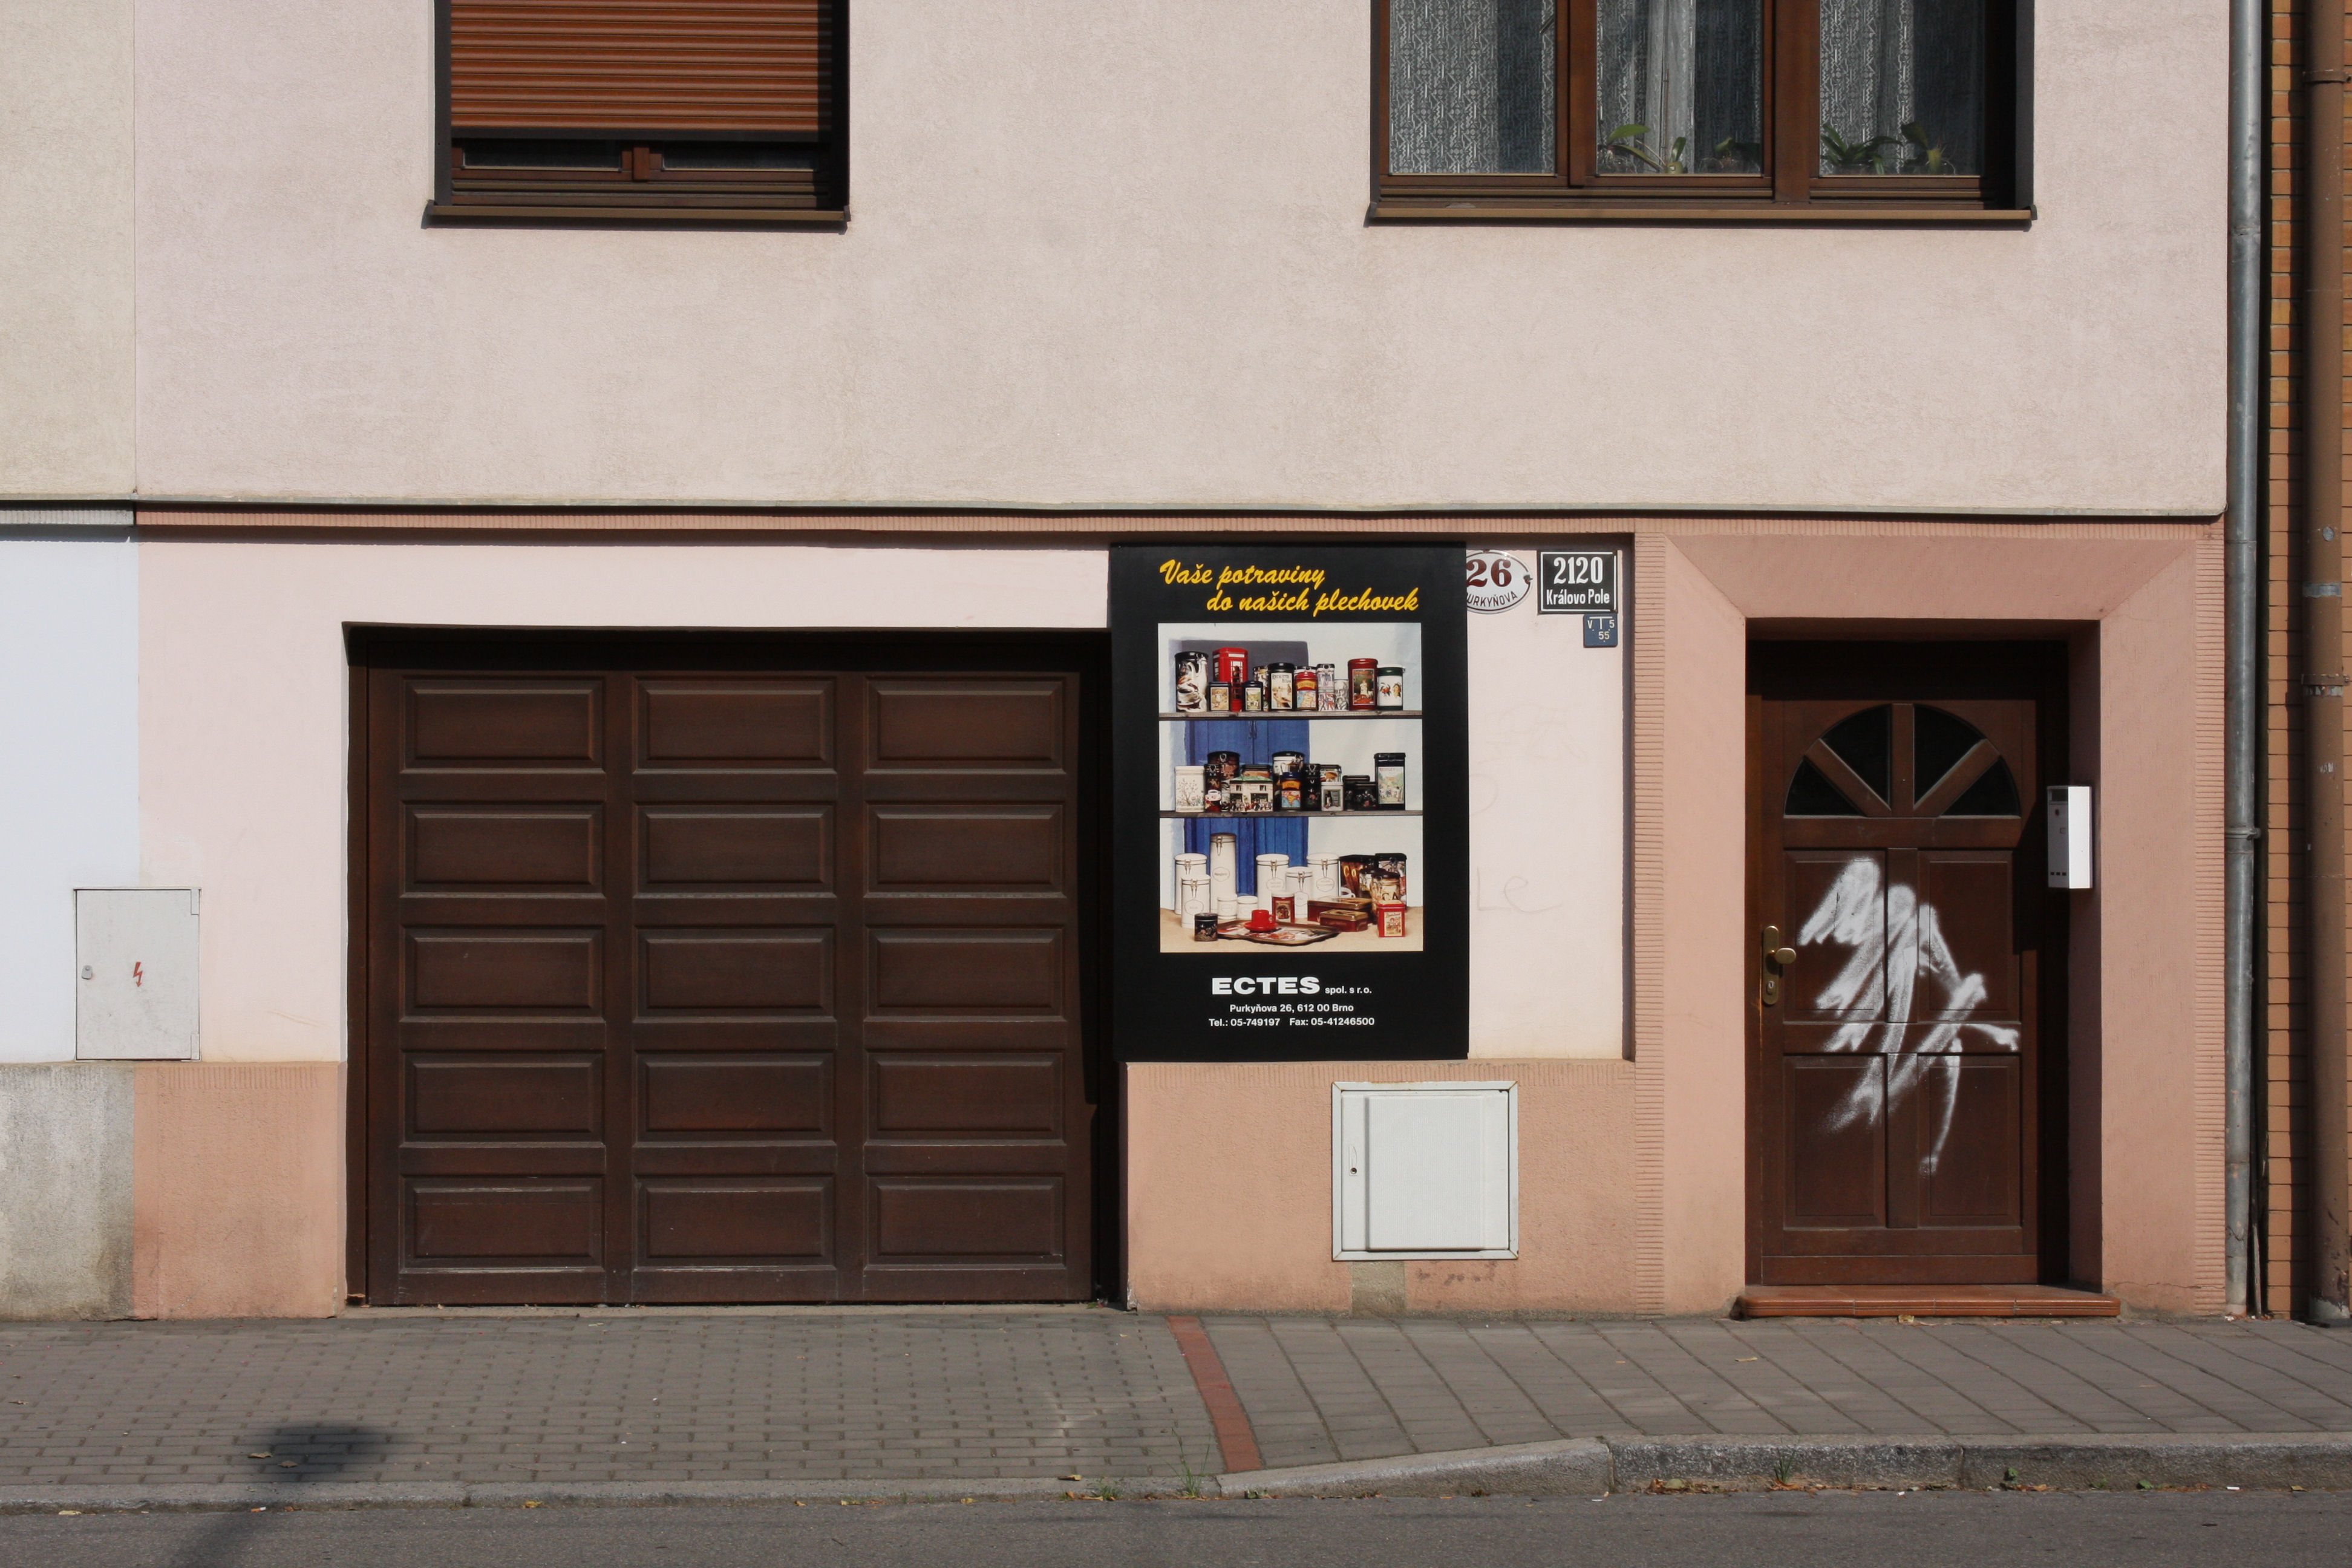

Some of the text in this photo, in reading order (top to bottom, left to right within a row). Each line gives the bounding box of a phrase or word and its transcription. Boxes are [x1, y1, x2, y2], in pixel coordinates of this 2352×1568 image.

[1160, 559, 1325, 590] Vaše potraviny
[1466, 558, 1512, 587] 26
[1553, 557, 1603, 584] 2120
[1206, 587, 1419, 617] do našich plechovek
[1466, 590, 1518, 607] URKYŇOVA
[1546, 589, 1610, 605] Královo Pole
[1212, 976, 1320, 995] ECTES
[1325, 985, 1347, 995] spol.
[1230, 1004, 1354, 1013] Purkyňova 26, 612 00 Brno
[1209, 1018, 1375, 1027] Tel.: 05-749197 Fax: 05-41246500
